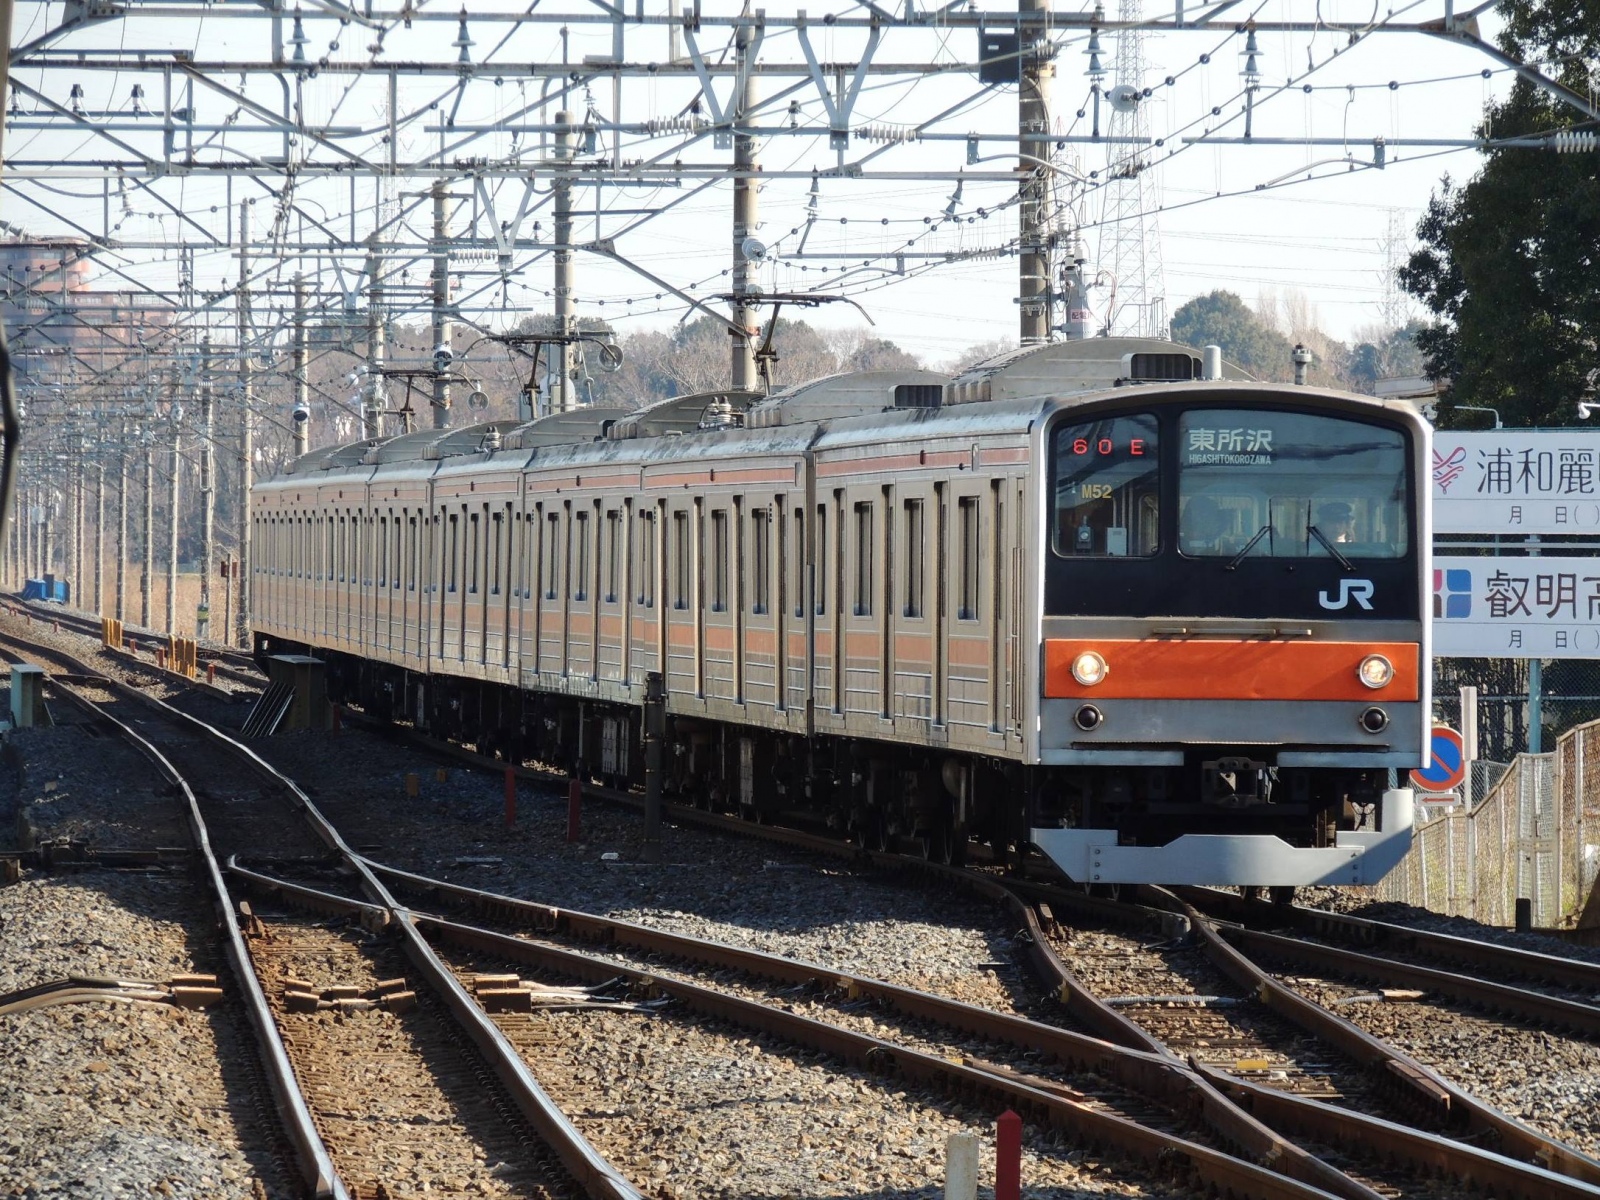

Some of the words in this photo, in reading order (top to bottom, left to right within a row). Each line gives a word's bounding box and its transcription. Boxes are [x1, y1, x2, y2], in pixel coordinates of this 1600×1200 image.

[1189, 428, 1273, 451] 東所沢
[1189, 454, 1271, 464] HIGASHITOKOROZAWA
[1477, 447, 1600, 494] 浦和麗
[1082, 484, 1112, 499] M52
[1509, 506, 1522, 525] 月
[1319, 579, 1374, 610] JR
[1509, 630, 1522, 648] 月
